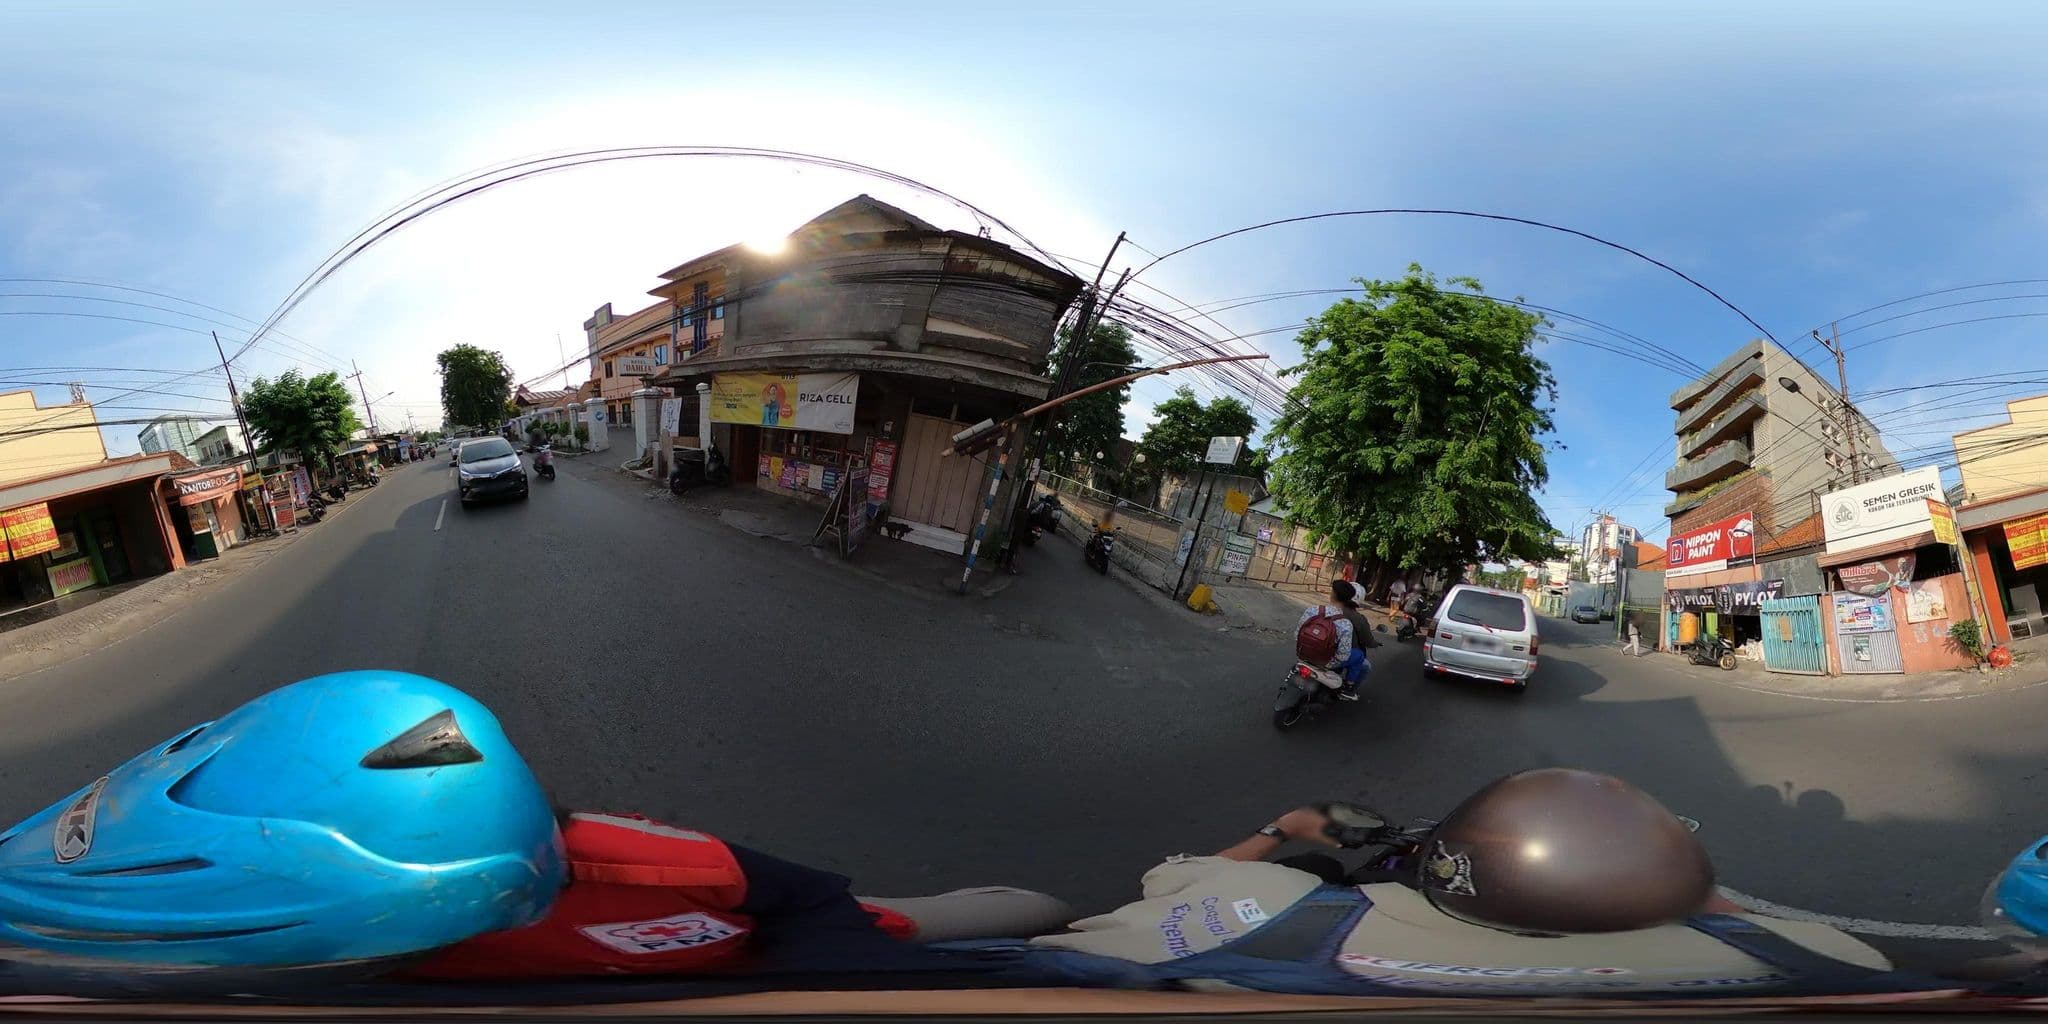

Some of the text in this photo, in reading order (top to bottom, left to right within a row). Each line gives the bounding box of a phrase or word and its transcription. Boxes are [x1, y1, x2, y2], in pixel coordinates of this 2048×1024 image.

[800, 392, 852, 404] RIZA CELL
[1863, 483, 1936, 507] SEMEN GRESIK
[1686, 529, 1721, 549] NIPPON
[1688, 543, 1715, 559] PAINT
[1685, 595, 1715, 606] PYLOX
[1735, 590, 1777, 606] PYLOX
[639, 930, 732, 950] PMI
